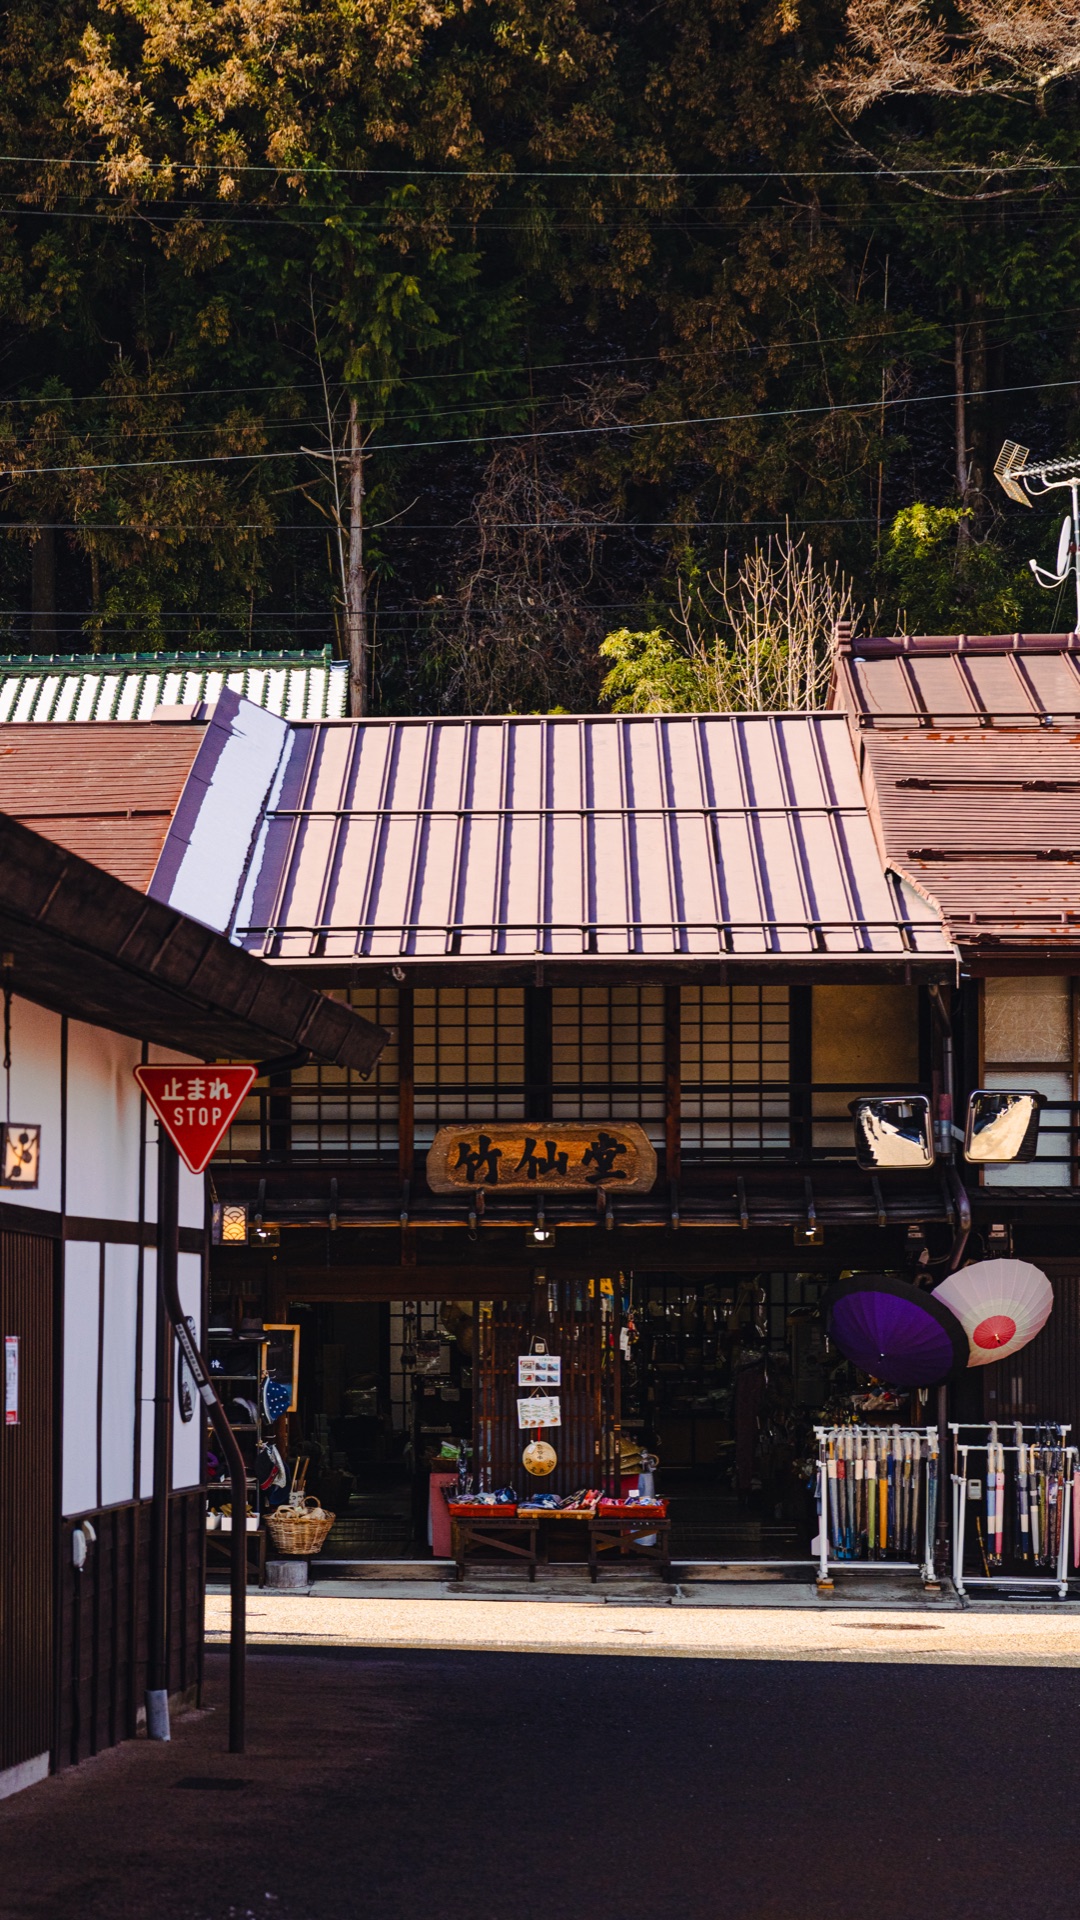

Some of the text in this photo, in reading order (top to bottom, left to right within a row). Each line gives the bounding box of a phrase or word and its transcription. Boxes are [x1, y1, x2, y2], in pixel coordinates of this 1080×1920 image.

[160, 1077, 232, 1101] 止まれ
[173, 1107, 222, 1127] STOP
[454, 1132, 627, 1184] 竹仙堂
